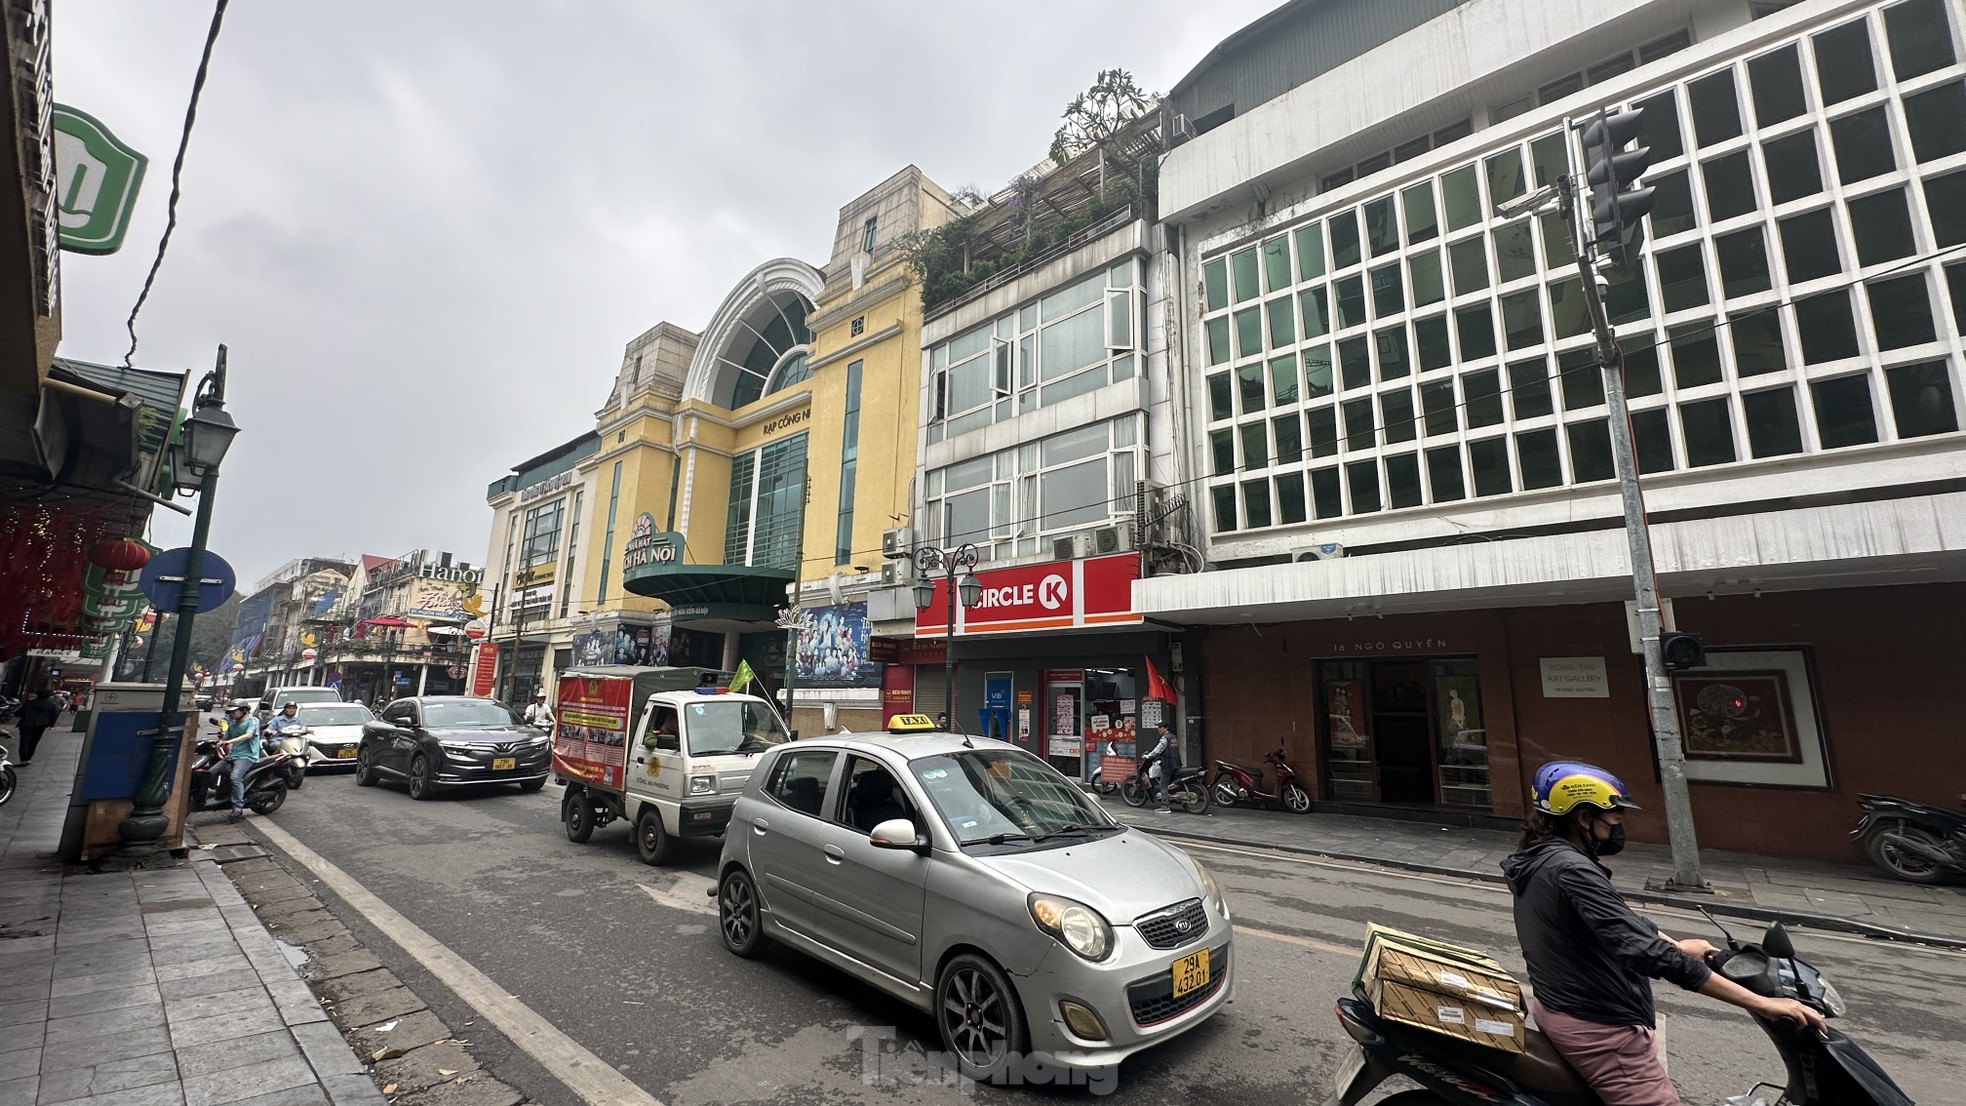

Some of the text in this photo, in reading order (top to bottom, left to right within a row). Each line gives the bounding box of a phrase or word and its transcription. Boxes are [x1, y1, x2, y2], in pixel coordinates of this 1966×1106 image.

[763, 421, 777, 435] RẠP
[778, 412, 801, 430] CÔNG
[633, 548, 648, 566] HÀ
[650, 544, 677, 565] NỘI
[418, 560, 484, 584] Hanoi
[1564, 675, 1602, 683] GALLERY
[901, 716, 929, 725] TAXI
[1183, 954, 1200, 974] 29A
[1177, 969, 1206, 994] 432.01
